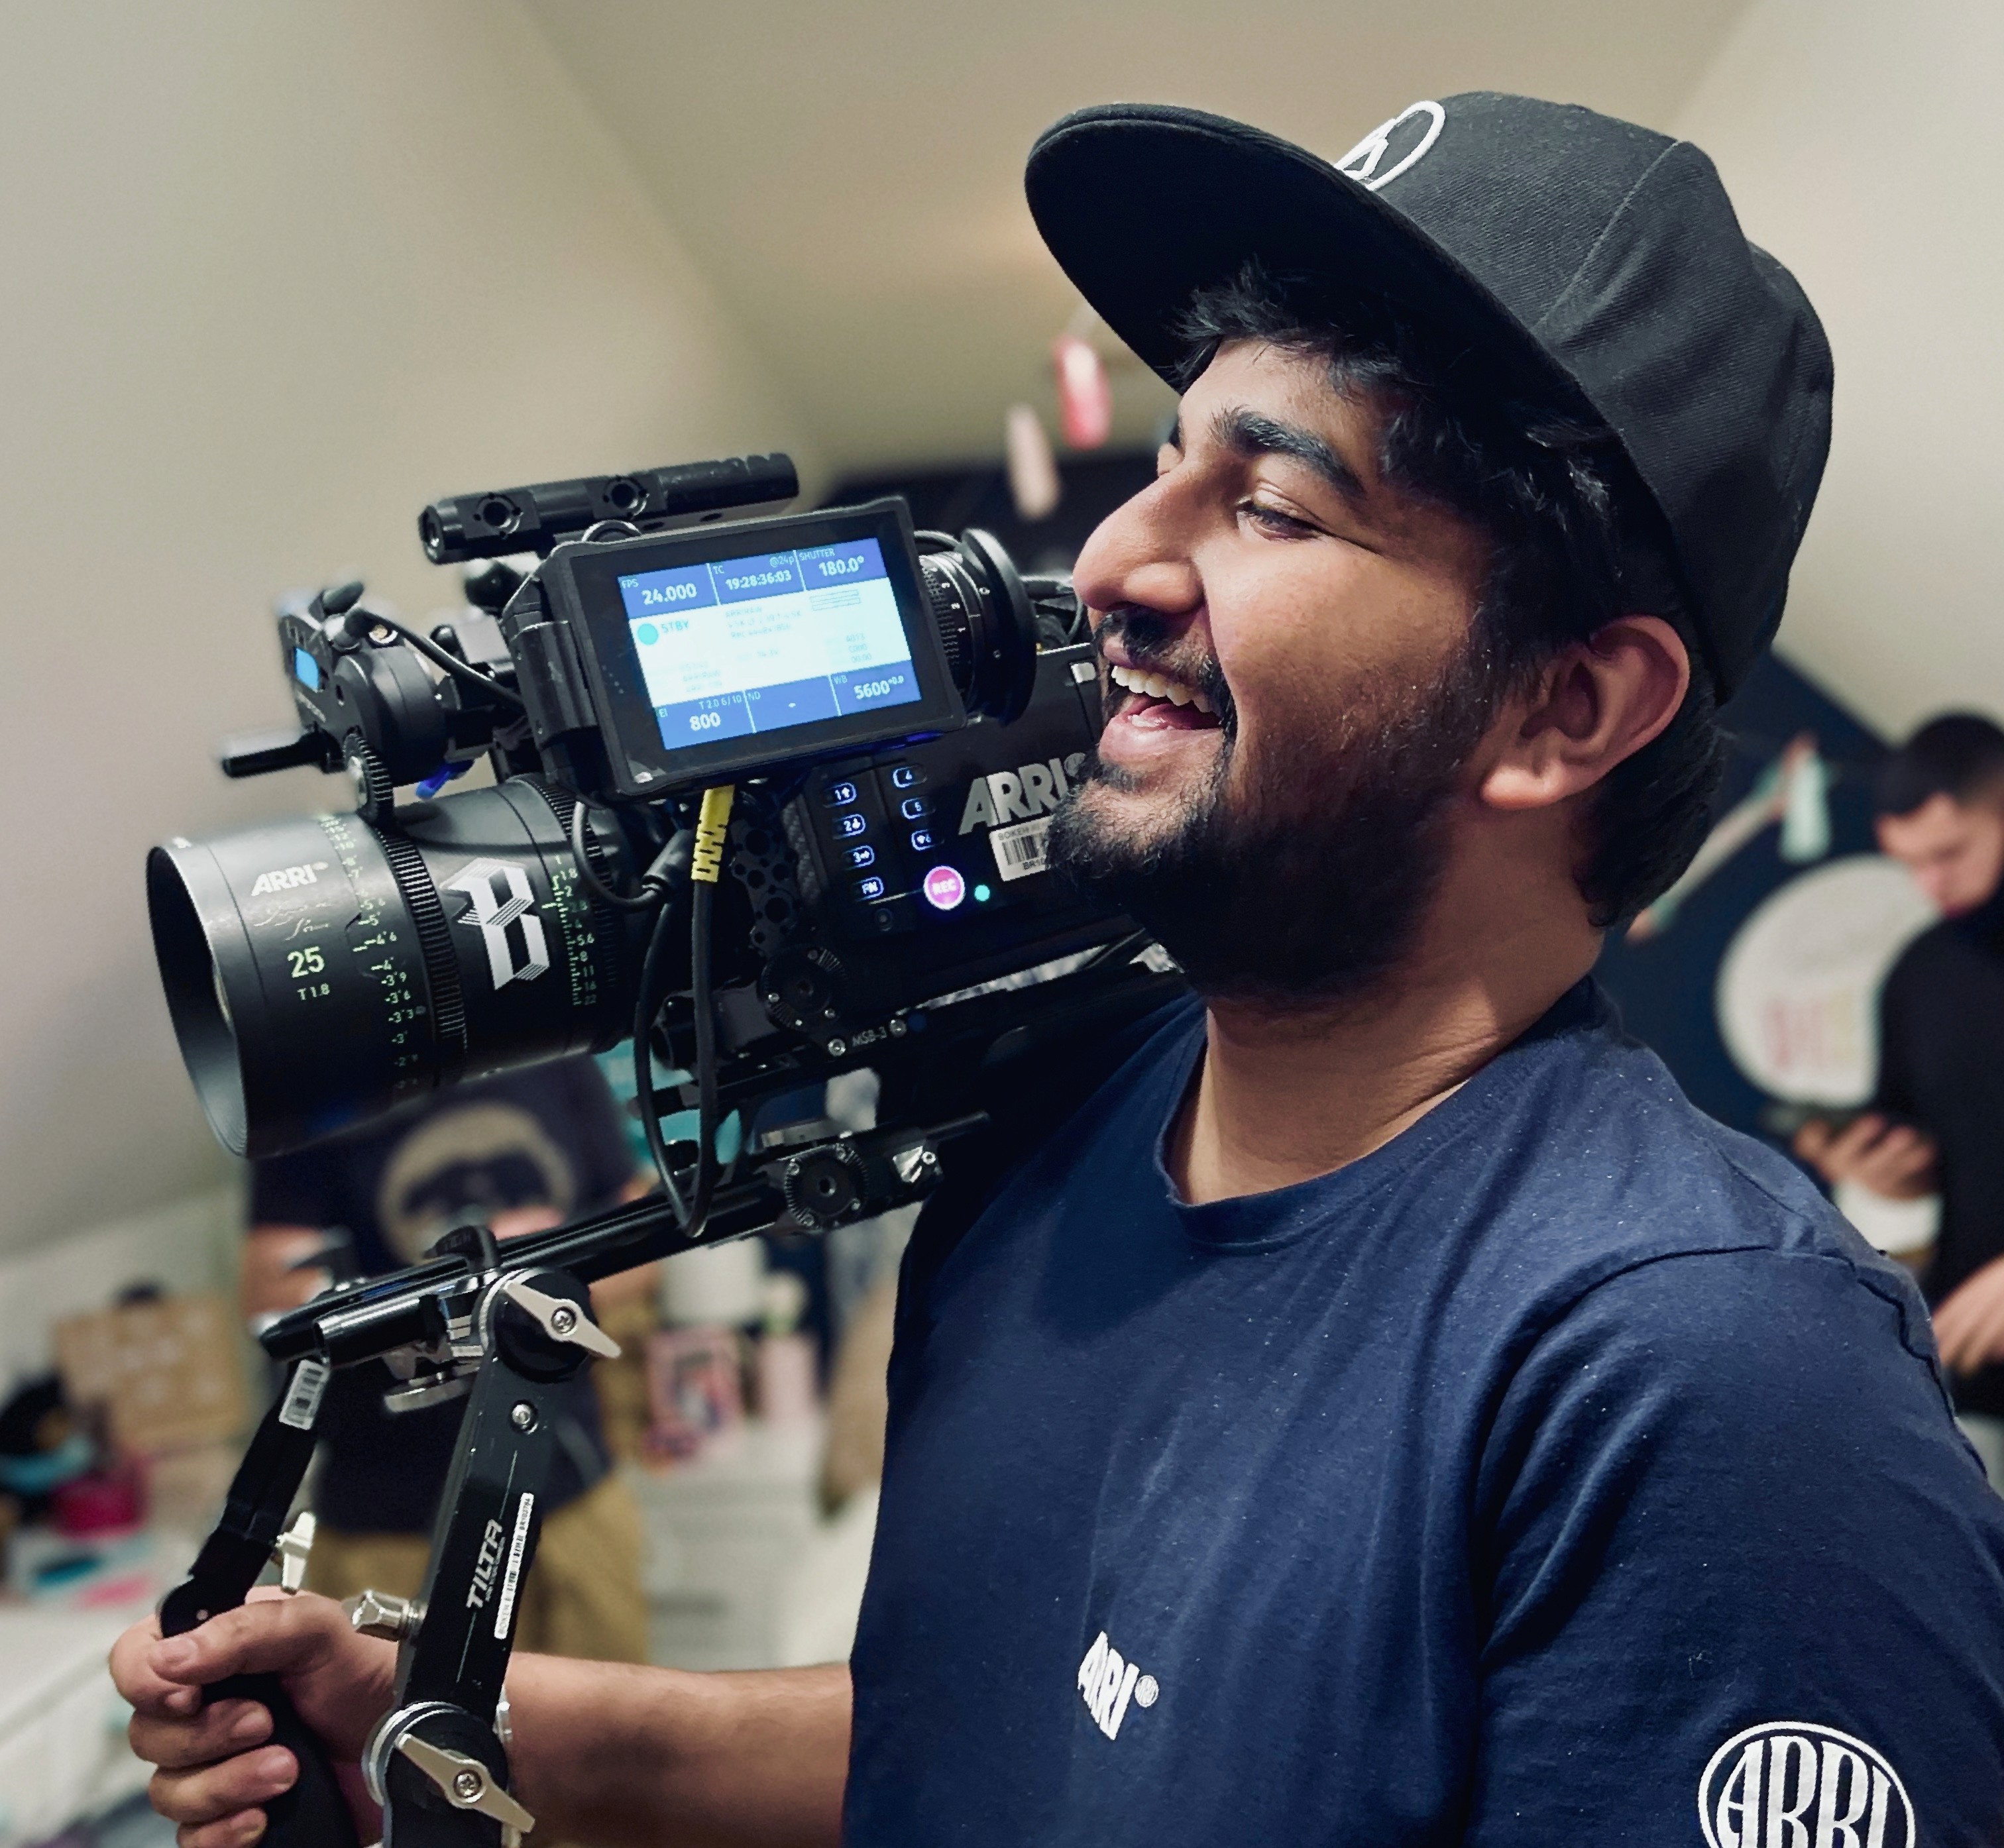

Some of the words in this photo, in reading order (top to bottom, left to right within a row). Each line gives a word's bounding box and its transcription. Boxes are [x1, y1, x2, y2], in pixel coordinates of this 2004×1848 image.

[799, 548, 835, 562] SHUTTER
[713, 565, 725, 574] TC
[769, 555, 795, 568] @24p
[622, 578, 639, 589] FPS
[642, 583, 697, 605] 24.000
[661, 620, 689, 634] STBY
[834, 675, 848, 685] WB
[748, 690, 761, 701] ND
[689, 712, 721, 731] 800
[932, 878, 956, 895] REC
[287, 946, 325, 978] 25
[466, 1519, 503, 1609] TILTA
